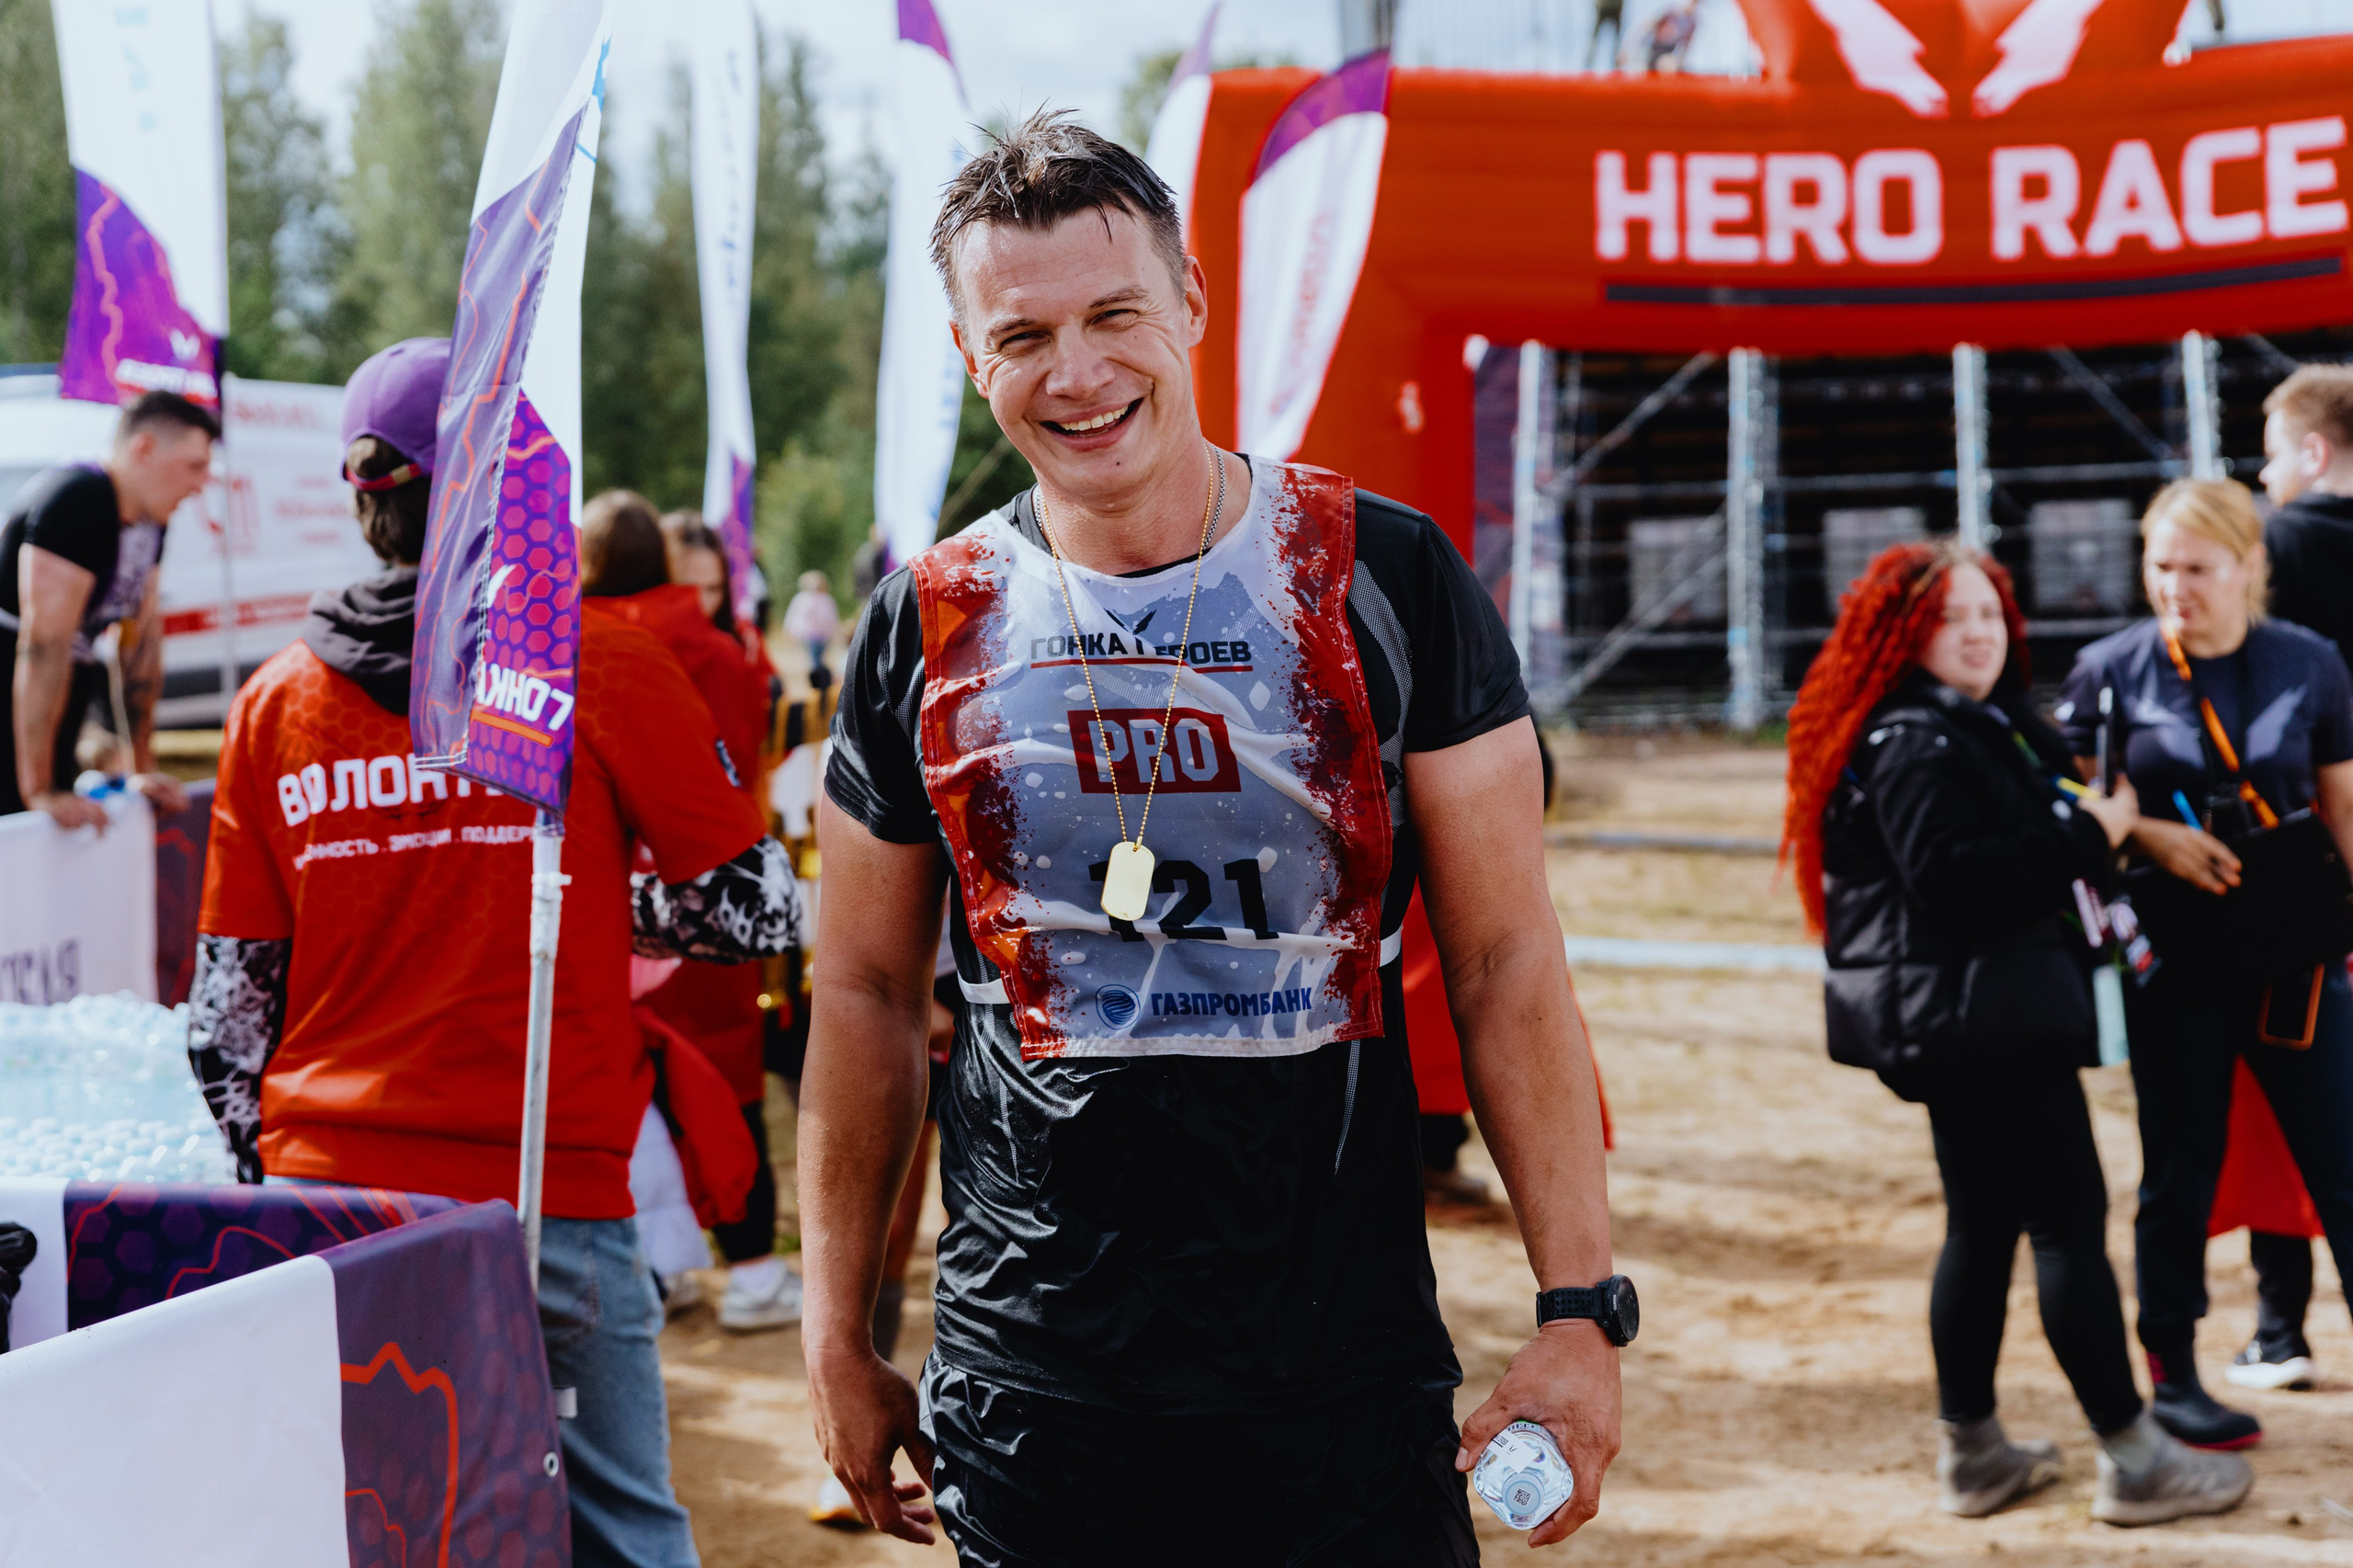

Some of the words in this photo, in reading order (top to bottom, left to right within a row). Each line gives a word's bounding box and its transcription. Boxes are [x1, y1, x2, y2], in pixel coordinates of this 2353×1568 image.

[1595, 148, 1945, 266] HERO
[1990, 115, 2349, 261] RACE
[1030, 632, 1128, 660] ГОНКА
[1087, 718, 1220, 783] PRO
[278, 752, 505, 827] ВОЛОН
[1151, 987, 1313, 1017] ГАЗПРОМБАНК
